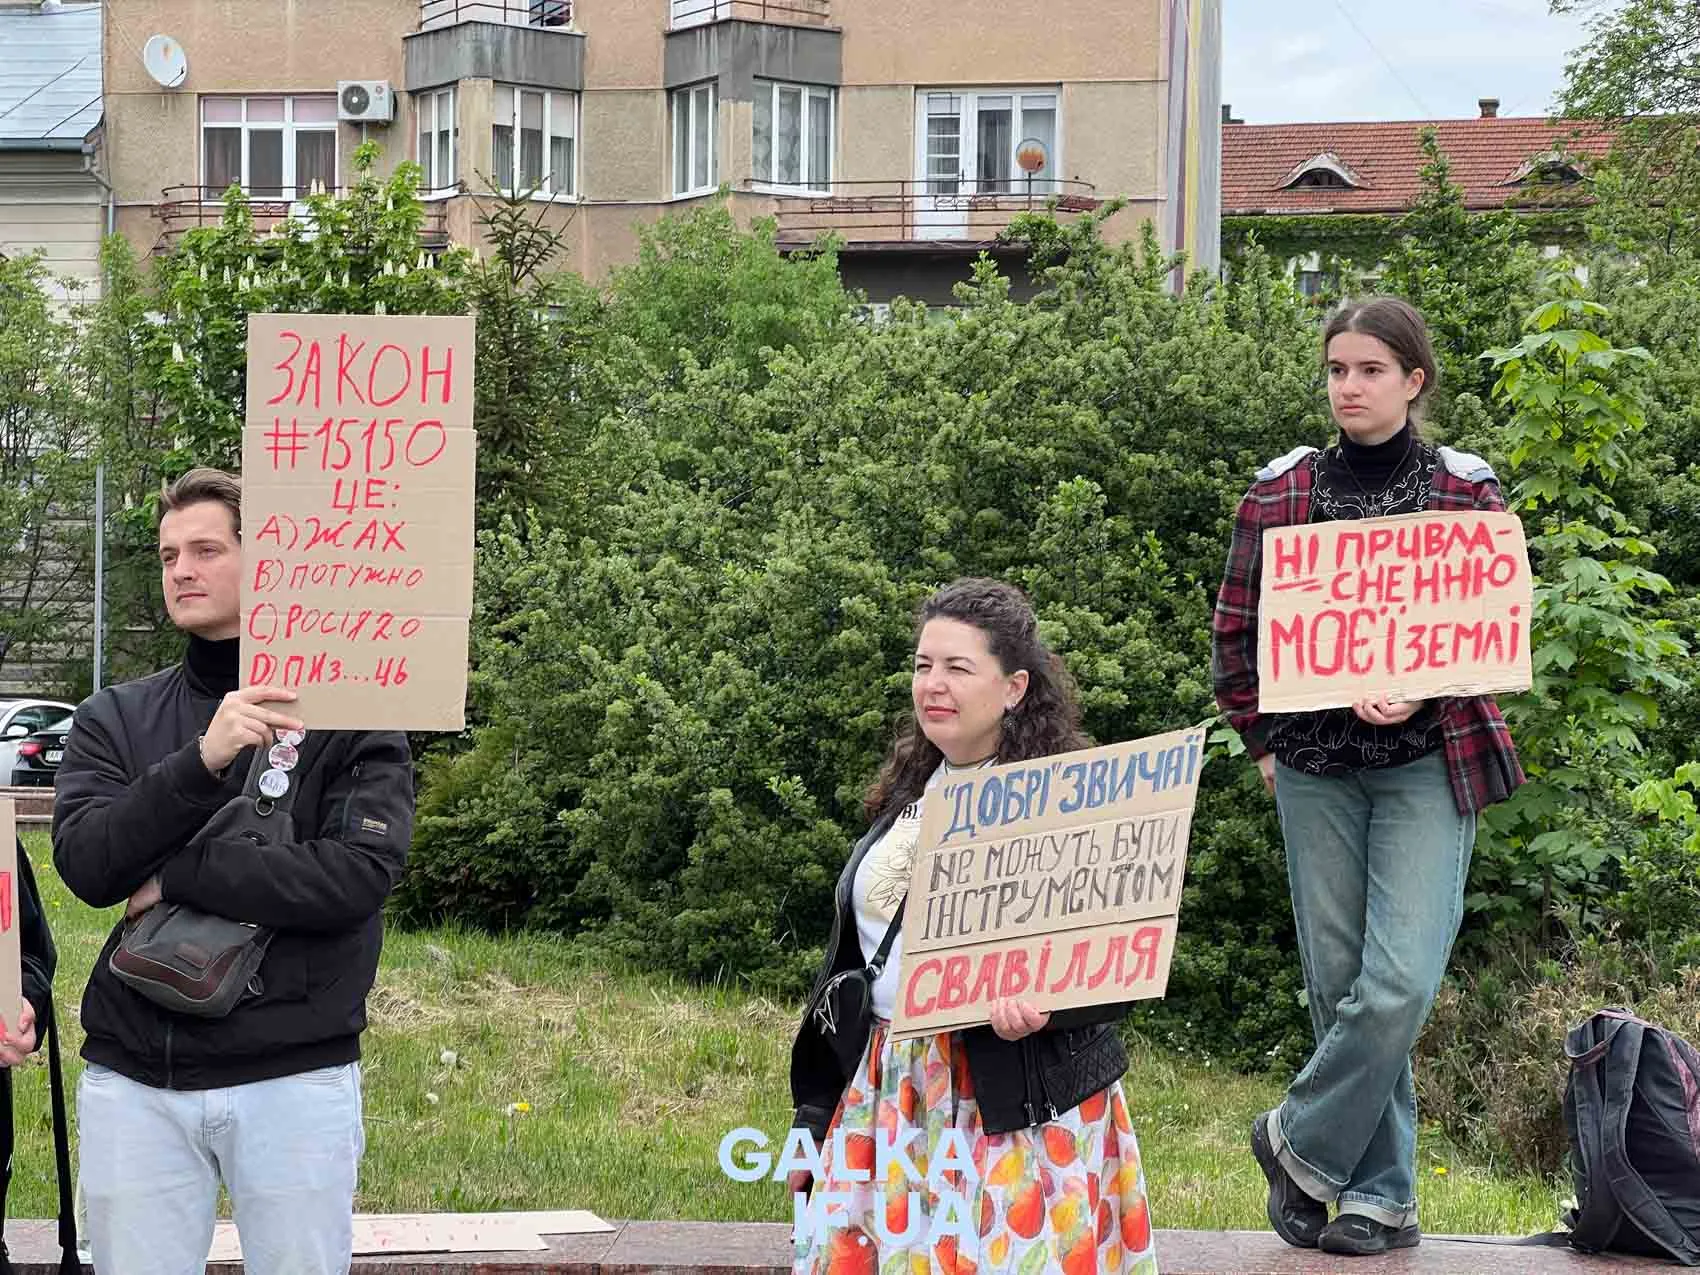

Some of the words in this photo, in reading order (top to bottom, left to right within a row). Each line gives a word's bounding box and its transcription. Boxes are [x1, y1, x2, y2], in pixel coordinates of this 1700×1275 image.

[267, 330, 454, 408] ЗАКОН
[263, 416, 447, 474] #15150
[331, 478, 401, 514] ЦЕ:
[1274, 532, 1320, 580] НІ
[1330, 554, 1518, 604] СНЕННЮ
[1270, 605, 1408, 682] МОЄЇ
[1403, 605, 1522, 673] ЗЕМЛІ
[983, 829, 1101, 881] МОЖУТЬ
[1110, 816, 1180, 864] БУТИ
[904, 926, 1164, 1018] СВАВІЛЛЯ
